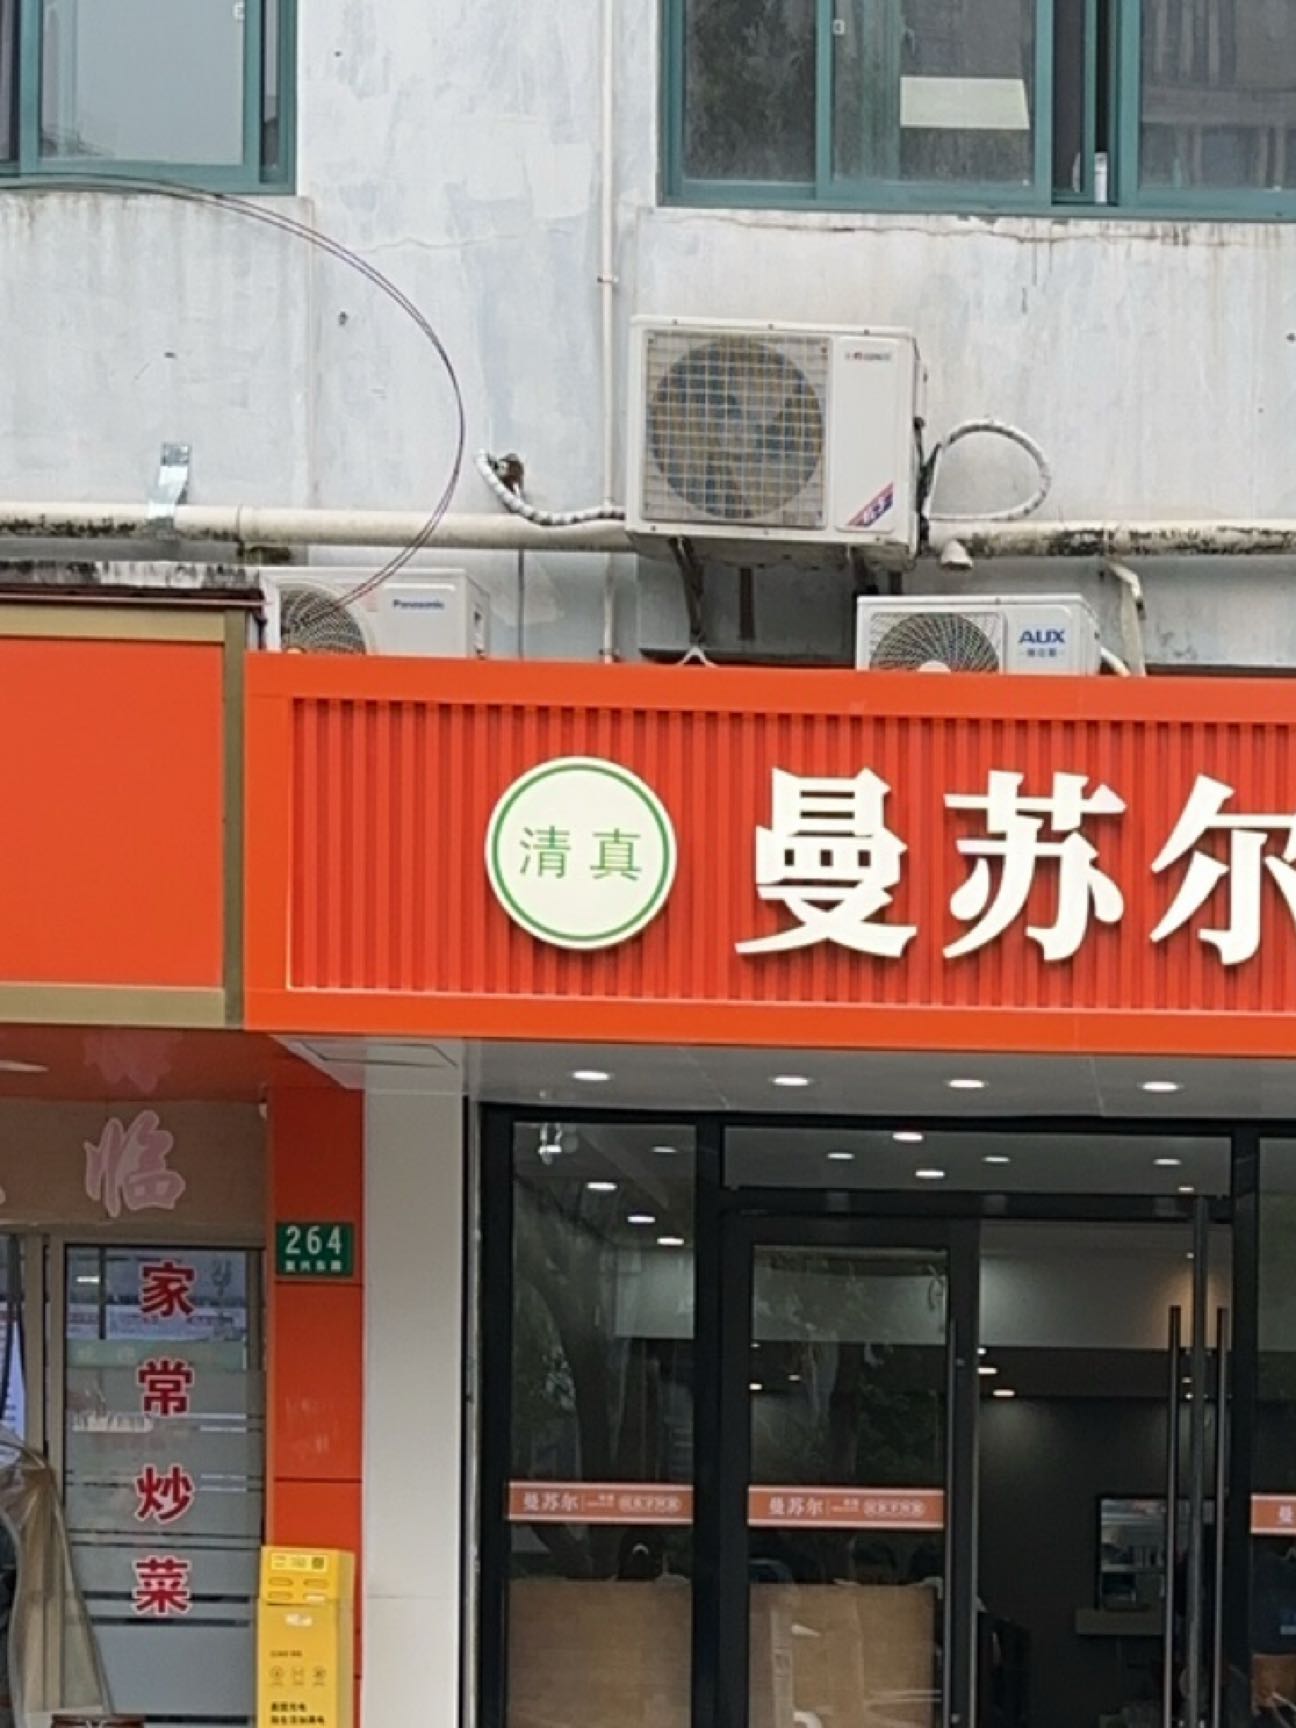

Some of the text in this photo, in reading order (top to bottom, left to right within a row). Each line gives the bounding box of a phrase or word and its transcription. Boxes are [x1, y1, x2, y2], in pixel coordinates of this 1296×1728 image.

[1018, 629, 1065, 644] AUX
[518, 825, 643, 880] 清真
[84, 1109, 186, 1218] 临
[286, 1225, 342, 1255] 264
[135, 1261, 196, 1614] 家常炒菜
